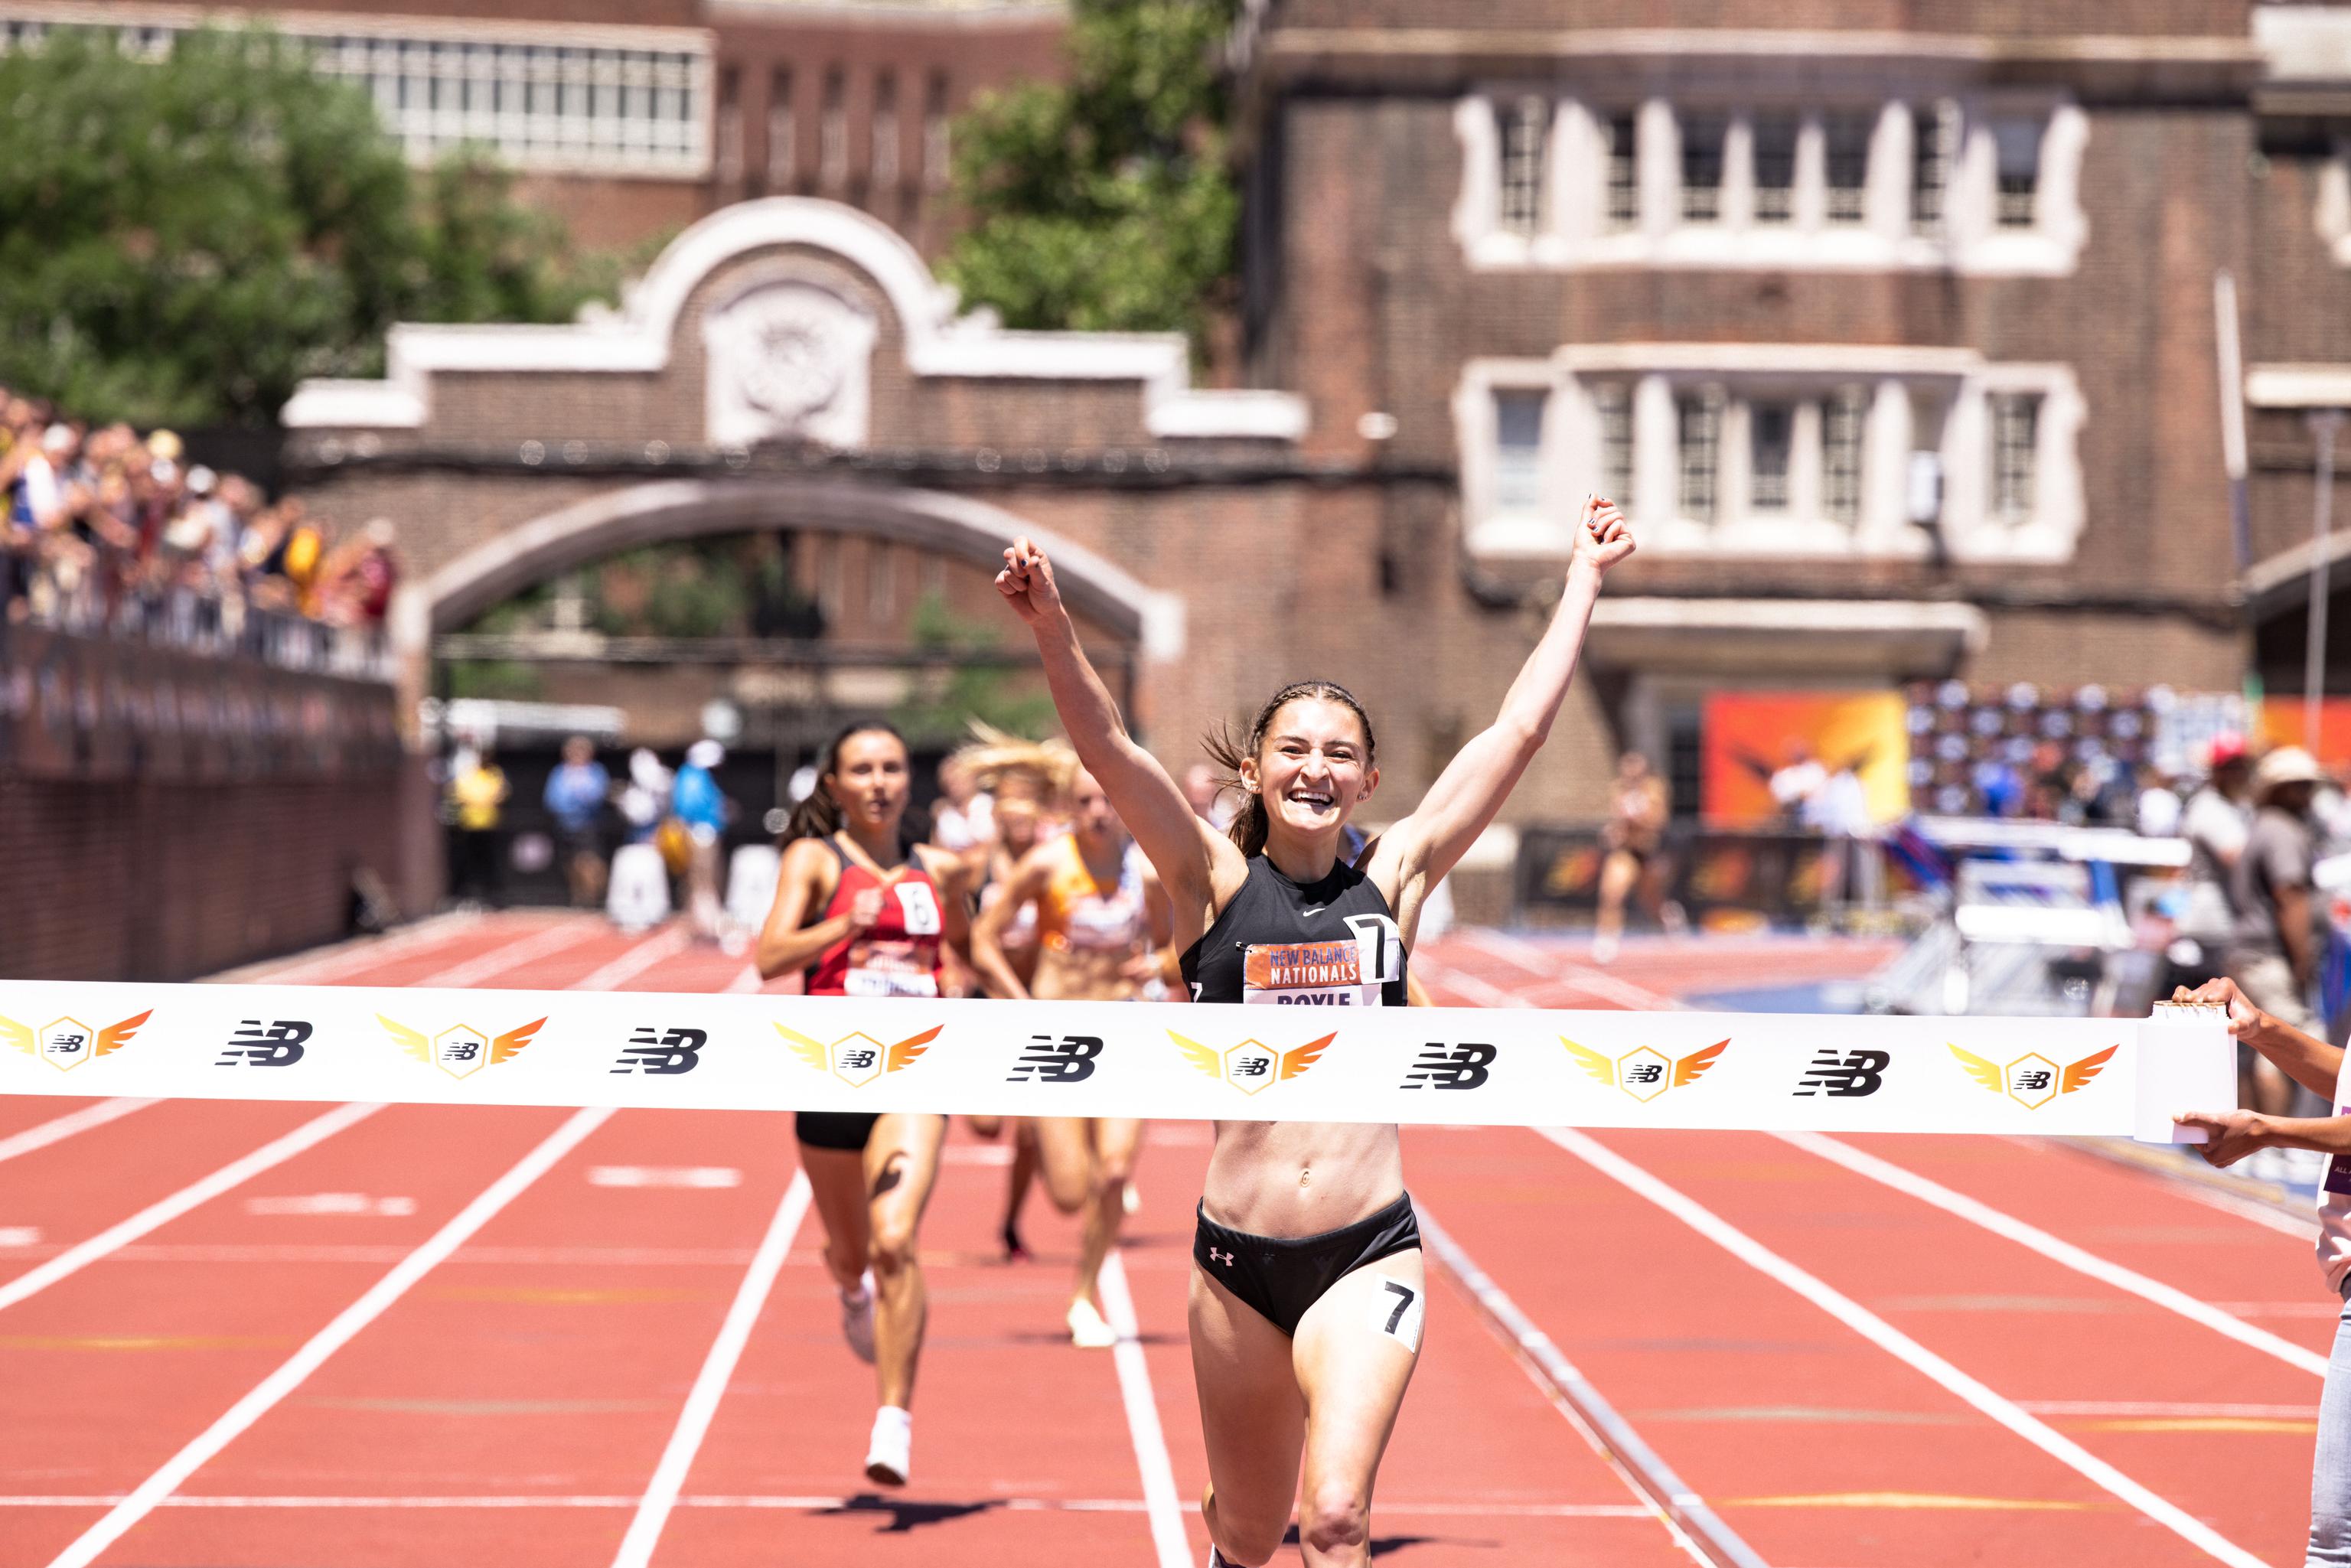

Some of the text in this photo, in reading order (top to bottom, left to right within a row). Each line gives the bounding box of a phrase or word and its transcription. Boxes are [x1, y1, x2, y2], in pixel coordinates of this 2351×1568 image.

[1270, 946, 1357, 967] NEW BALANCE
[1355, 918, 1385, 979] 7
[1190, 981, 1203, 1003] 7
[1270, 963, 1358, 985] NATIONALS
[214, 1020, 313, 1067] NB
[609, 1028, 707, 1074] NB
[1006, 1035, 1104, 1083] NB
[1399, 1042, 1497, 1090] NB
[1792, 1049, 1890, 1097] NB
[1384, 1280, 1415, 1335] 7
